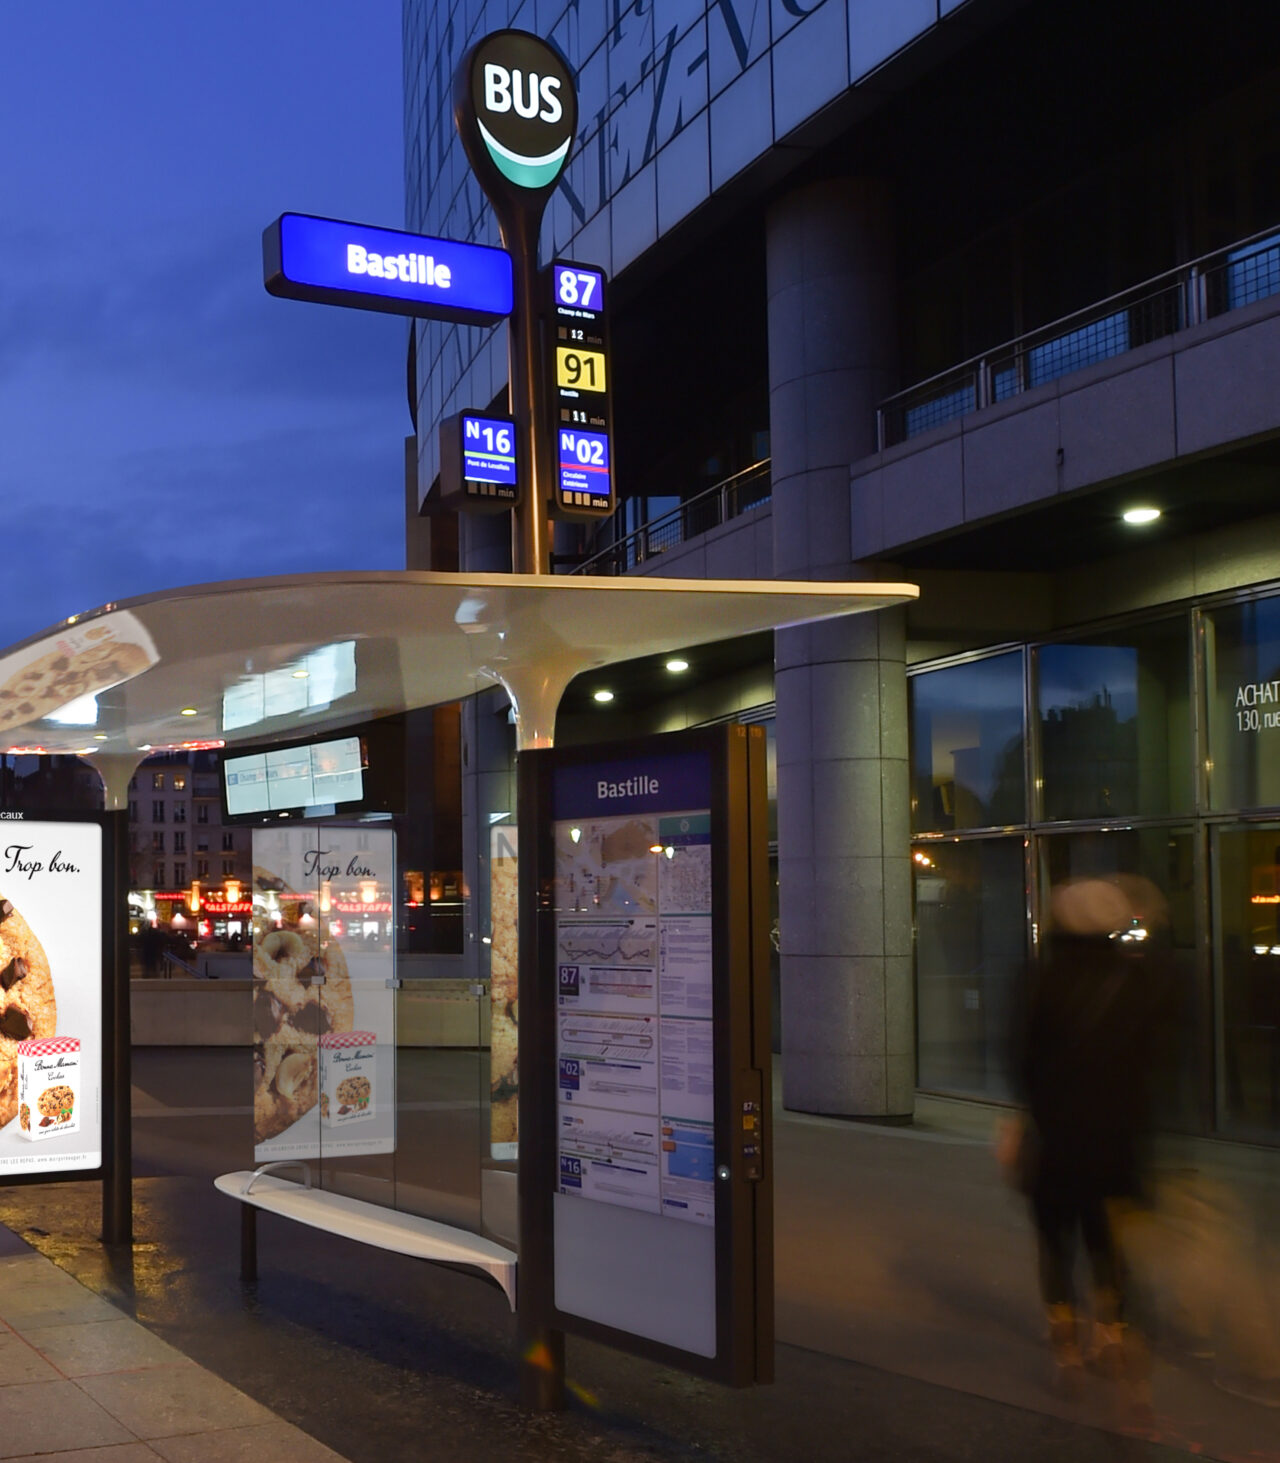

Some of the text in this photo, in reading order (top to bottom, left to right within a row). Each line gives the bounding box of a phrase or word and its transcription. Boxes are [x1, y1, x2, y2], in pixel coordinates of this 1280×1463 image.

[484, 63, 562, 124] BUS
[346, 244, 452, 288] Bastille
[560, 270, 596, 306] 87
[571, 329, 583, 340] 12
[564, 354, 595, 386] 91
[573, 410, 605, 426] 11 min
[498, 488, 514, 498] min
[592, 498, 608, 508] min
[1237, 709, 1261, 733] 130,
[597, 775, 659, 799] Bastille
[4, 845, 80, 880] Trop bon.
[304, 850, 376, 881] Trop bon.
[561, 968, 577, 984] 87
[743, 1102, 753, 1111] 87
